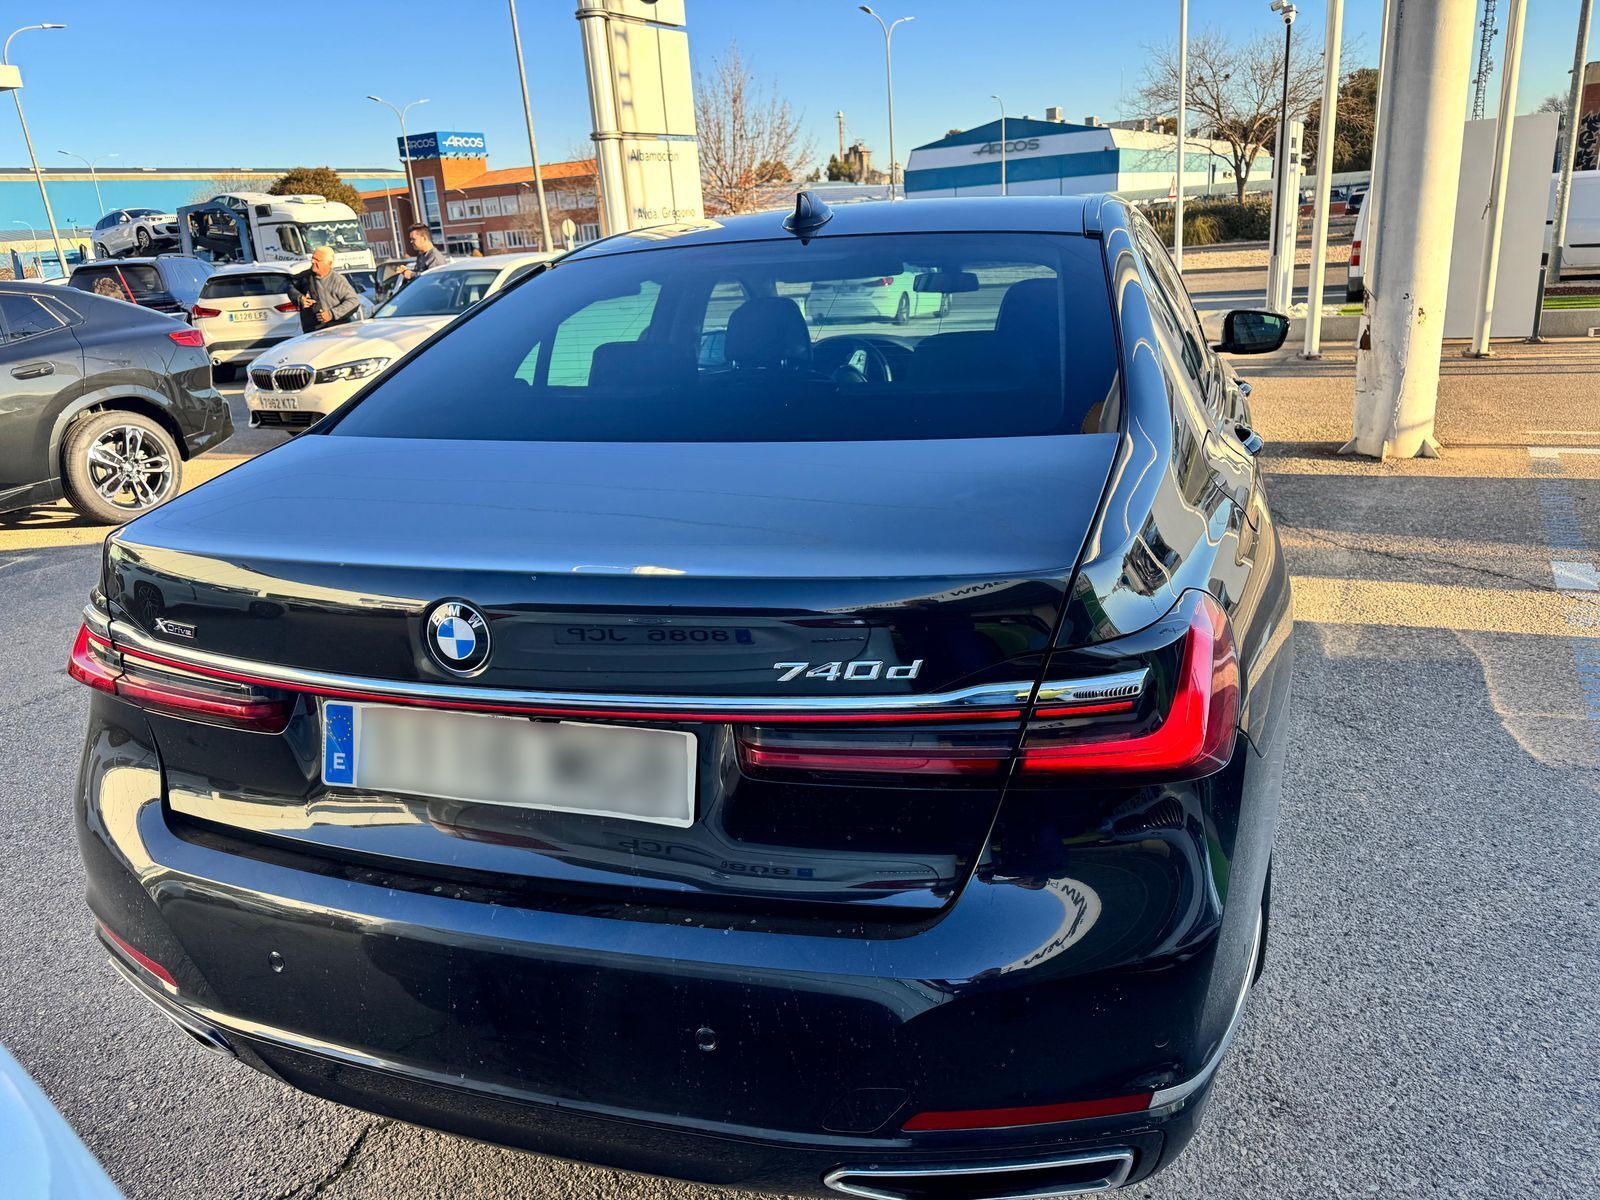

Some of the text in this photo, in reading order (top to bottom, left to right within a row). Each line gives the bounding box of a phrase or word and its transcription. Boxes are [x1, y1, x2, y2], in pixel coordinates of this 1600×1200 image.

[442, 135, 484, 148] ARCOS
[973, 138, 1040, 156] ARCOS
[431, 604, 483, 629] BMW
[773, 659, 924, 682] 740d
[333, 752, 346, 770] E
